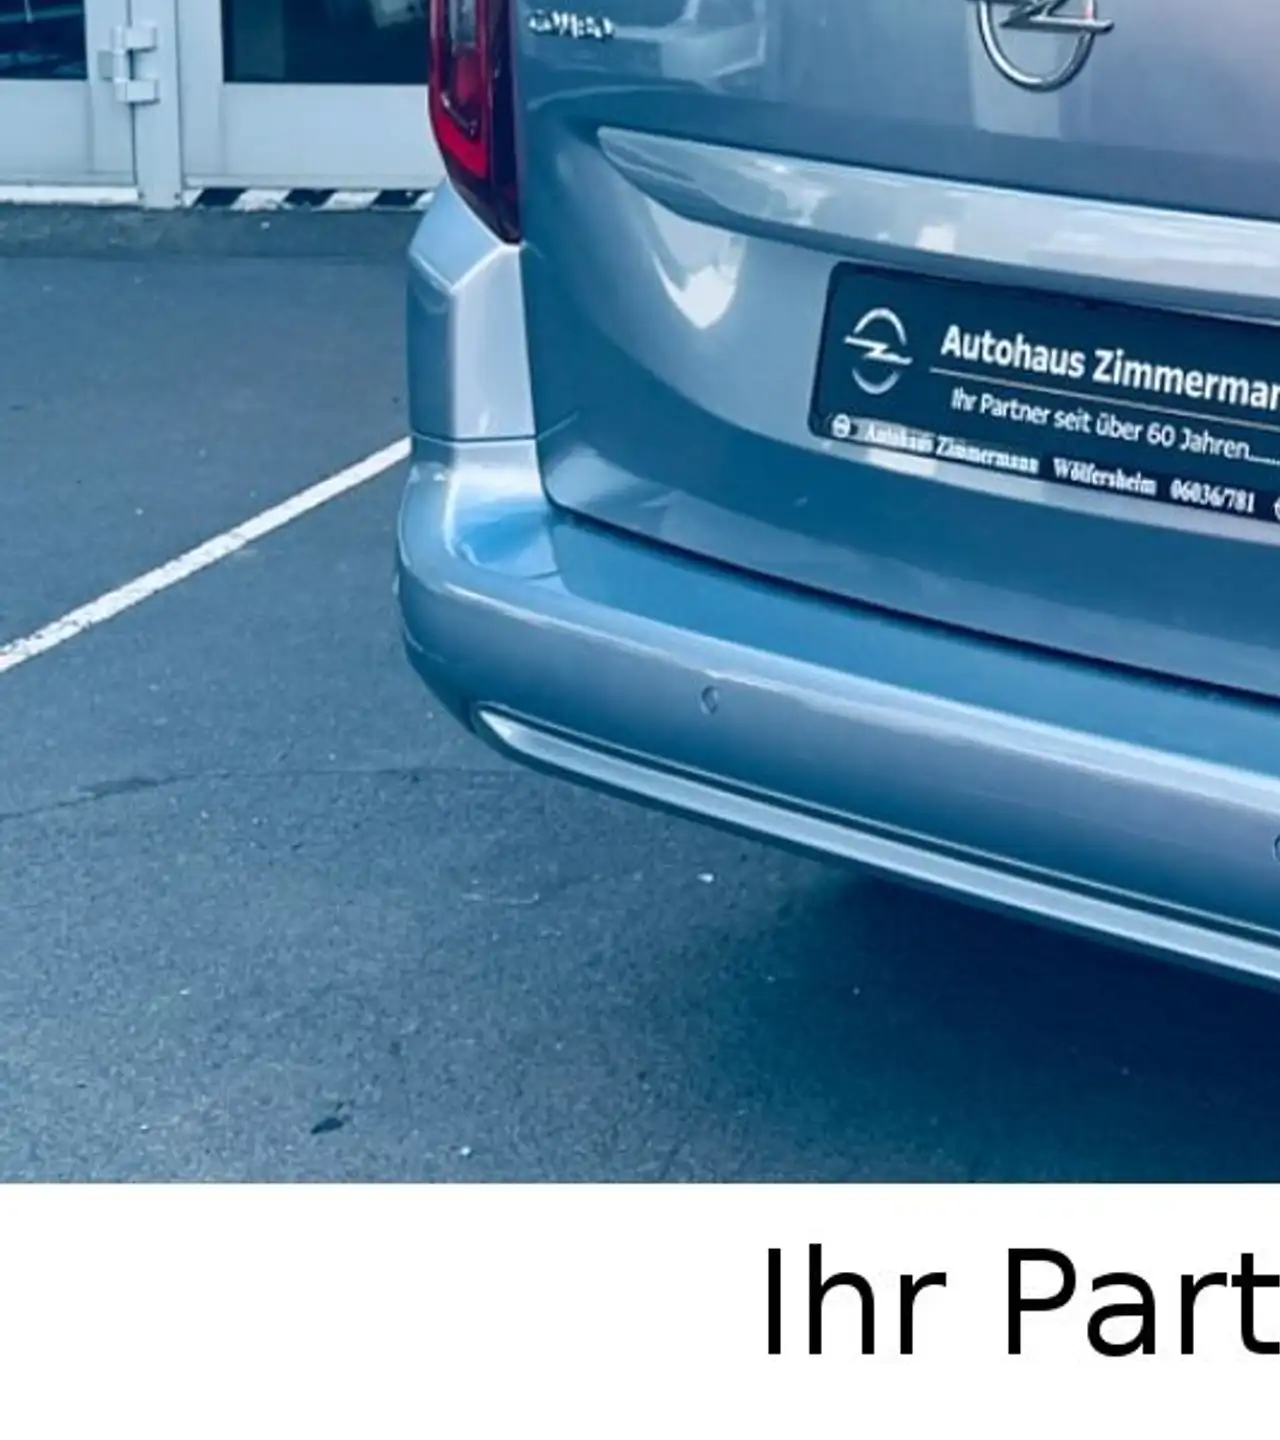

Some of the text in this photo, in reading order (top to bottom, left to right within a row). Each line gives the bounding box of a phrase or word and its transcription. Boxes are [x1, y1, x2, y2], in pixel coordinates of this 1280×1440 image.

[940, 323, 1086, 379] Autohaus
[951, 386, 978, 412] Ihr
[979, 392, 1050, 425] Partner
[1053, 407, 1093, 434] seit
[1095, 412, 1143, 442] über
[1146, 421, 1176, 448] 60
[864, 422, 1256, 513] Autohaus Zimmermann Wölfersheim 06036/781
